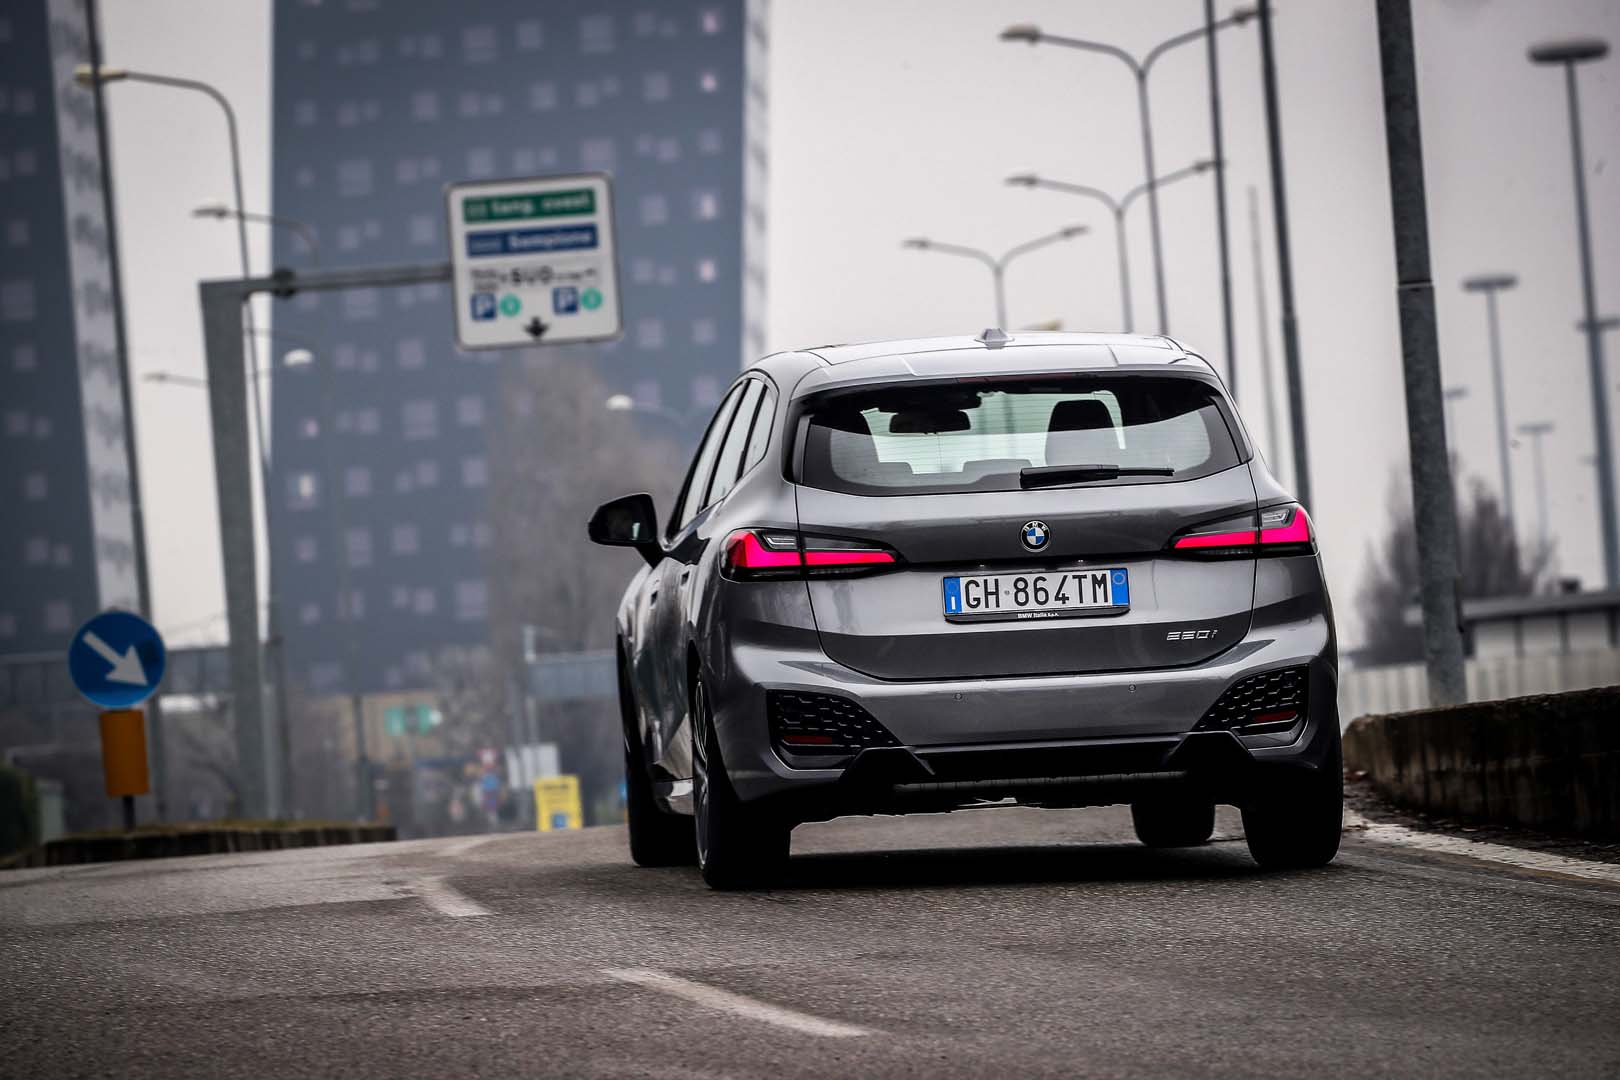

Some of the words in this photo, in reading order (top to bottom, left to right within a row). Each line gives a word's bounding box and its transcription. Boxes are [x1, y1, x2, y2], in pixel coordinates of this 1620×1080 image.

[1023, 521, 1049, 532] BMW
[964, 578, 1000, 609] GH
[1017, 611, 1033, 619] BMW
